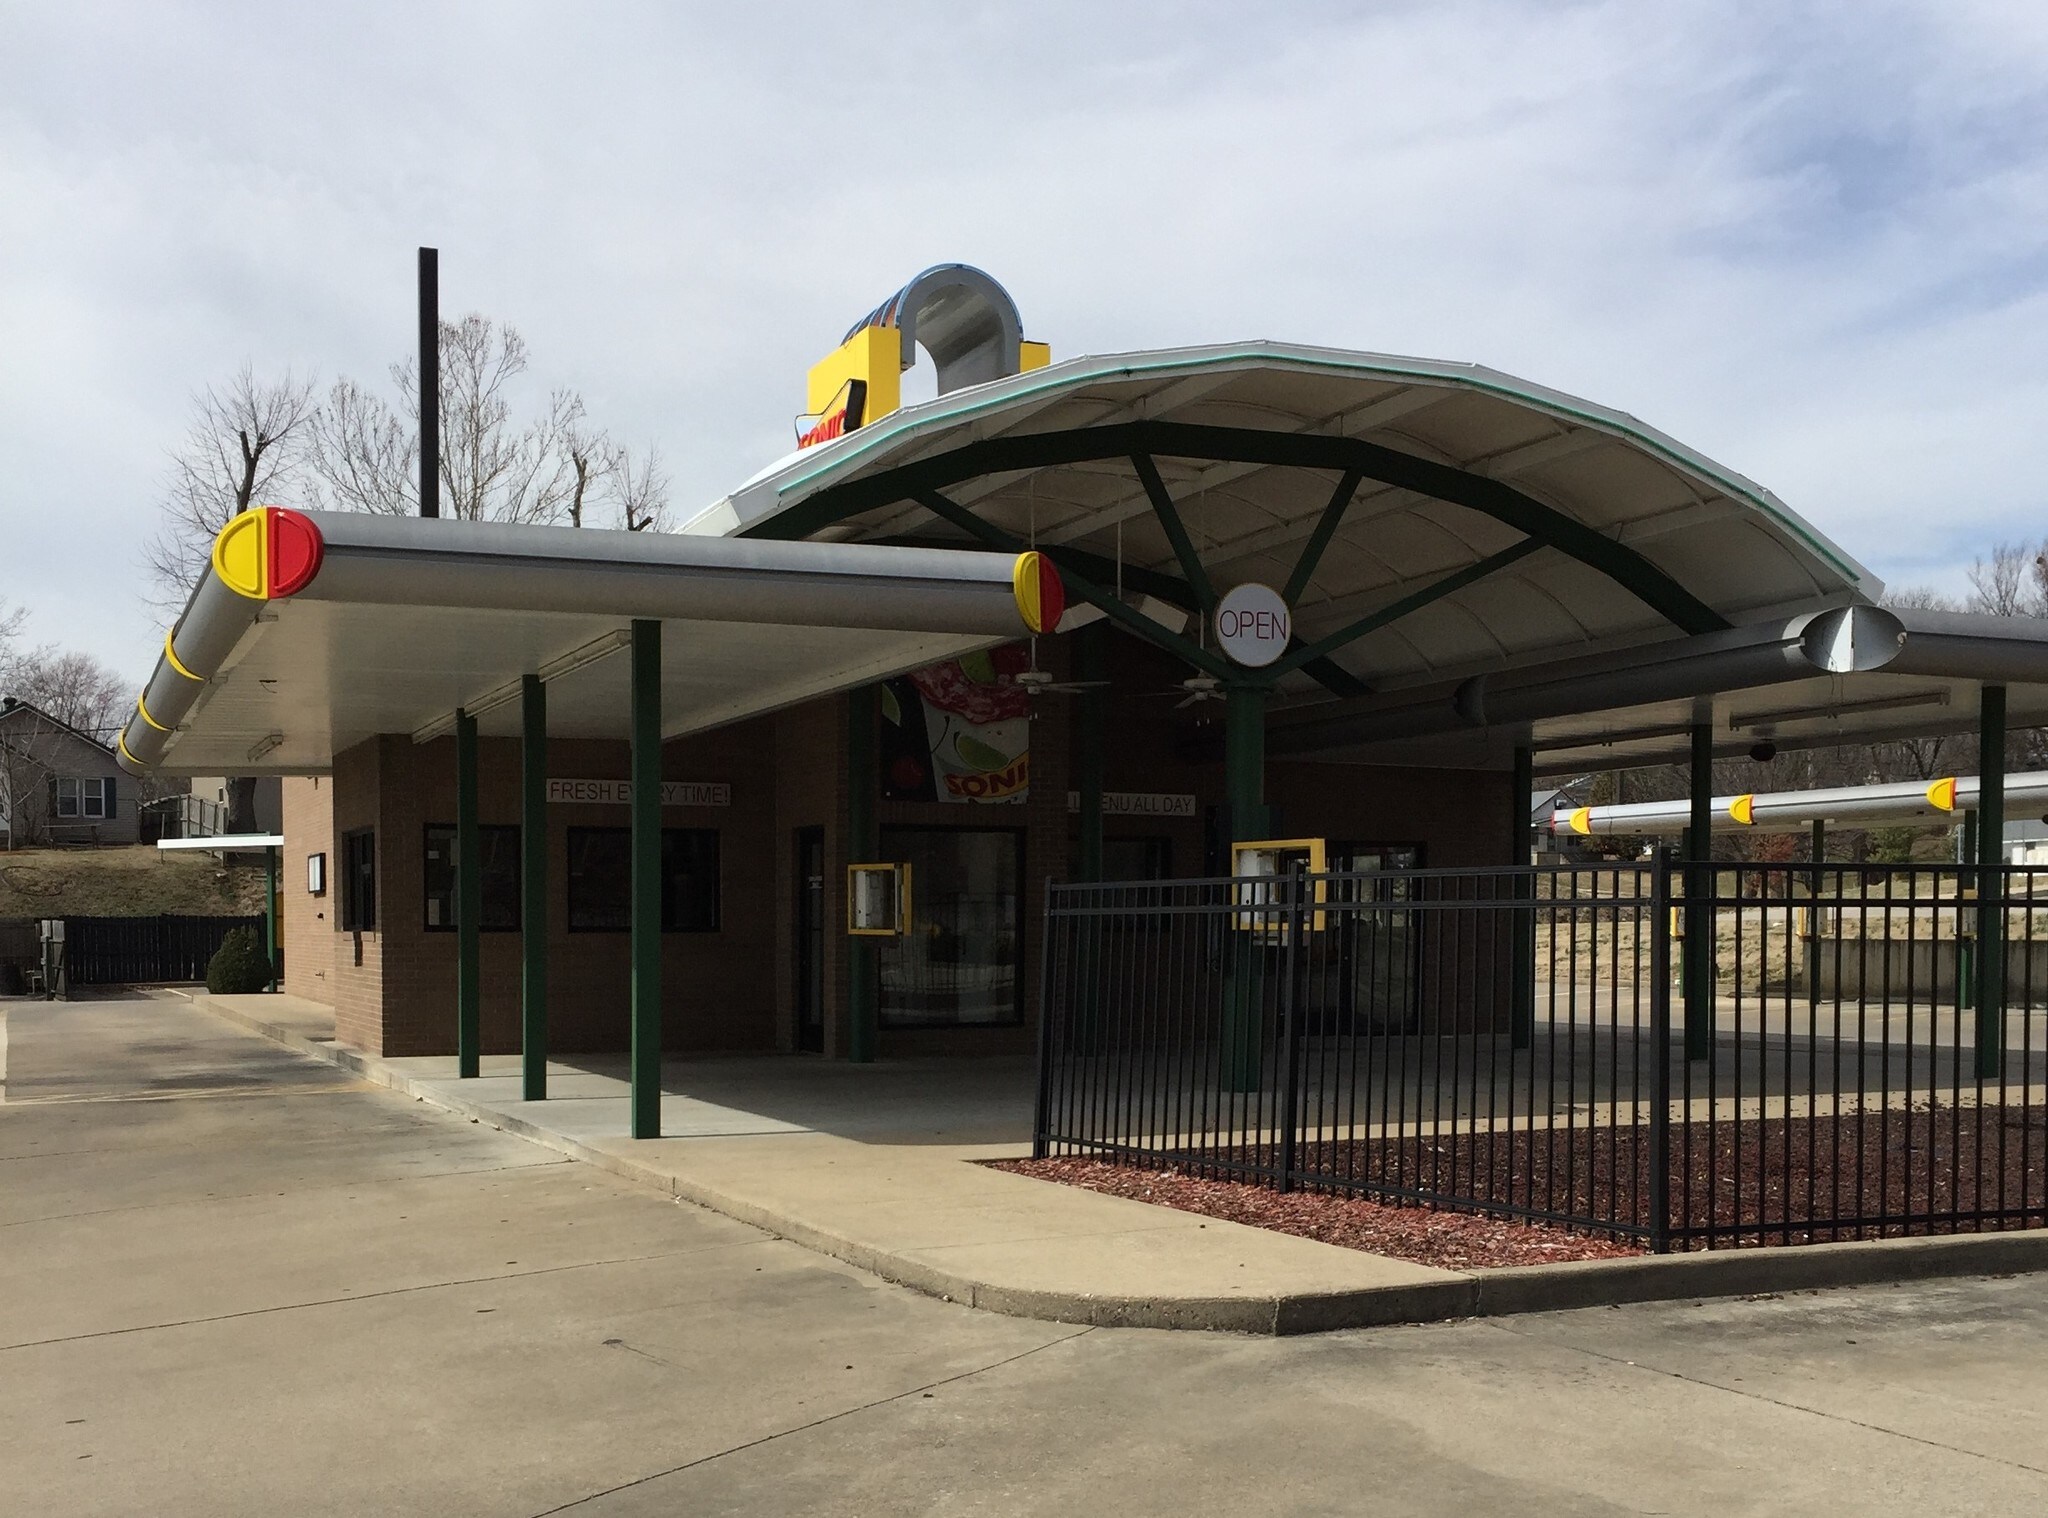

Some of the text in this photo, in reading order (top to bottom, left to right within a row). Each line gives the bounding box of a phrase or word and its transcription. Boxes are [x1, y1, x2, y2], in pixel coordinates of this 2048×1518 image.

[1219, 609, 1287, 640] OPEN
[550, 781, 611, 801] FRESH
[680, 785, 728, 804] TIME!
[943, 761, 1027, 797] SONI
[1103, 794, 1191, 813] ENU ALL DAY
